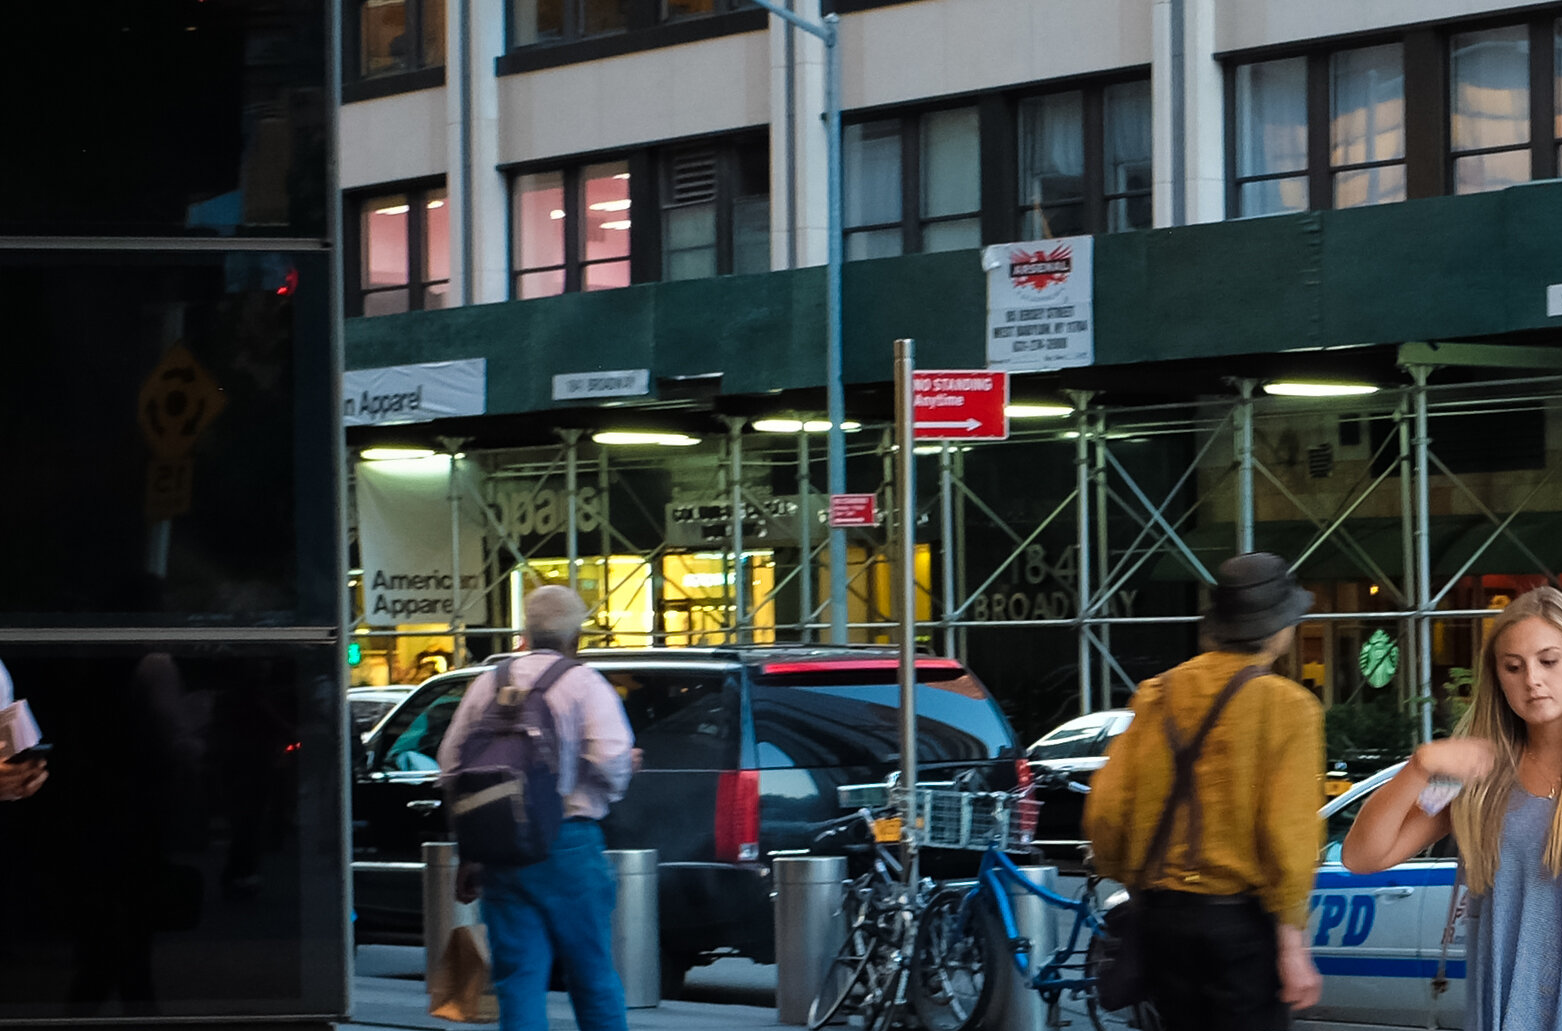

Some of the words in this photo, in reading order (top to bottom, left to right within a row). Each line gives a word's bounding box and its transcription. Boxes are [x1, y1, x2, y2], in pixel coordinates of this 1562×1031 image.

[1013, 261, 1069, 275] ARSENAL
[912, 378, 932, 391] NO
[933, 378, 994, 391] STANDING
[360, 384, 423, 419] Apparel
[913, 394, 965, 409] Anytime
[372, 594, 453, 619] Appare
[974, 590, 1138, 621] BROADAY
